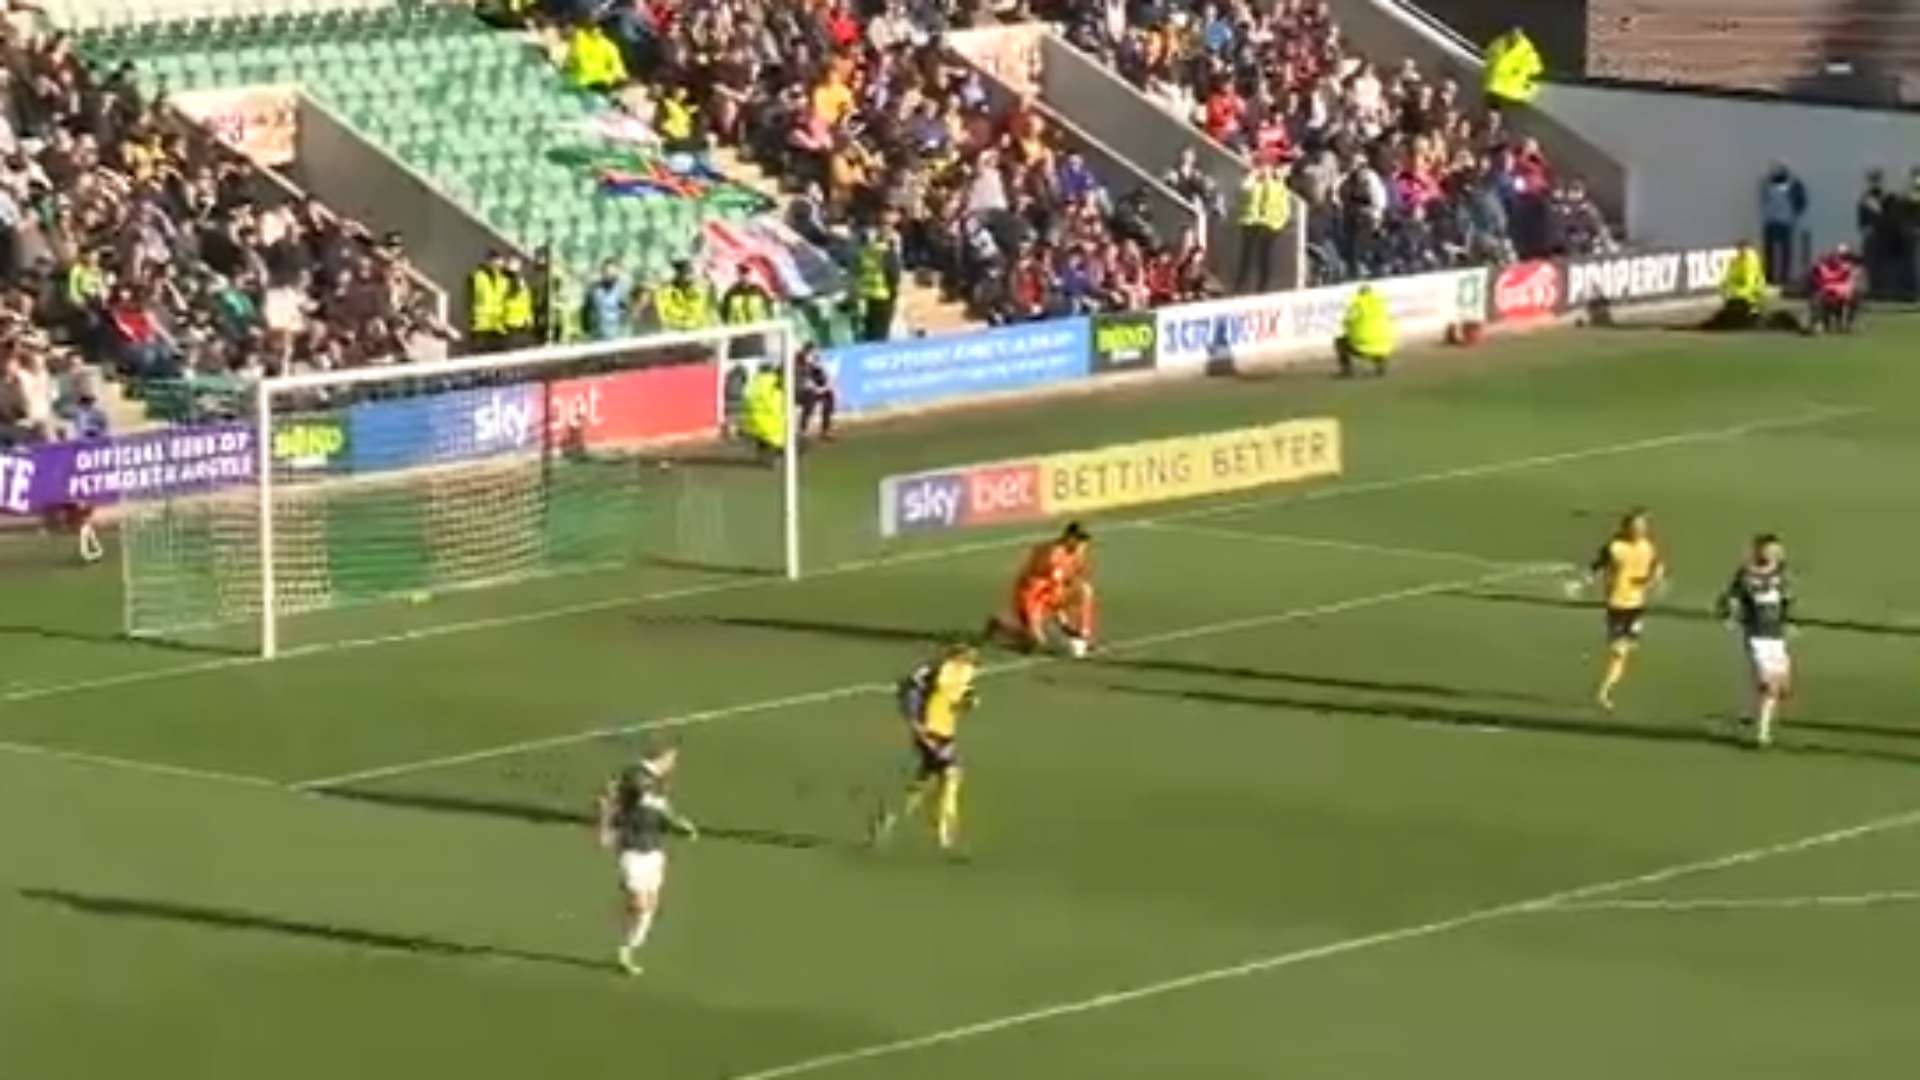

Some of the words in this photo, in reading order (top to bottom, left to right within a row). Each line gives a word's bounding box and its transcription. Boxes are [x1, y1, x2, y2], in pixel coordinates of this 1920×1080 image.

[1686, 248, 1738, 289] TAST
[473, 388, 531, 444] sky
[903, 478, 962, 526] sky
[970, 471, 1037, 510] bet
[1053, 452, 1192, 501] BETTING
[1212, 431, 1328, 477] BETTER
